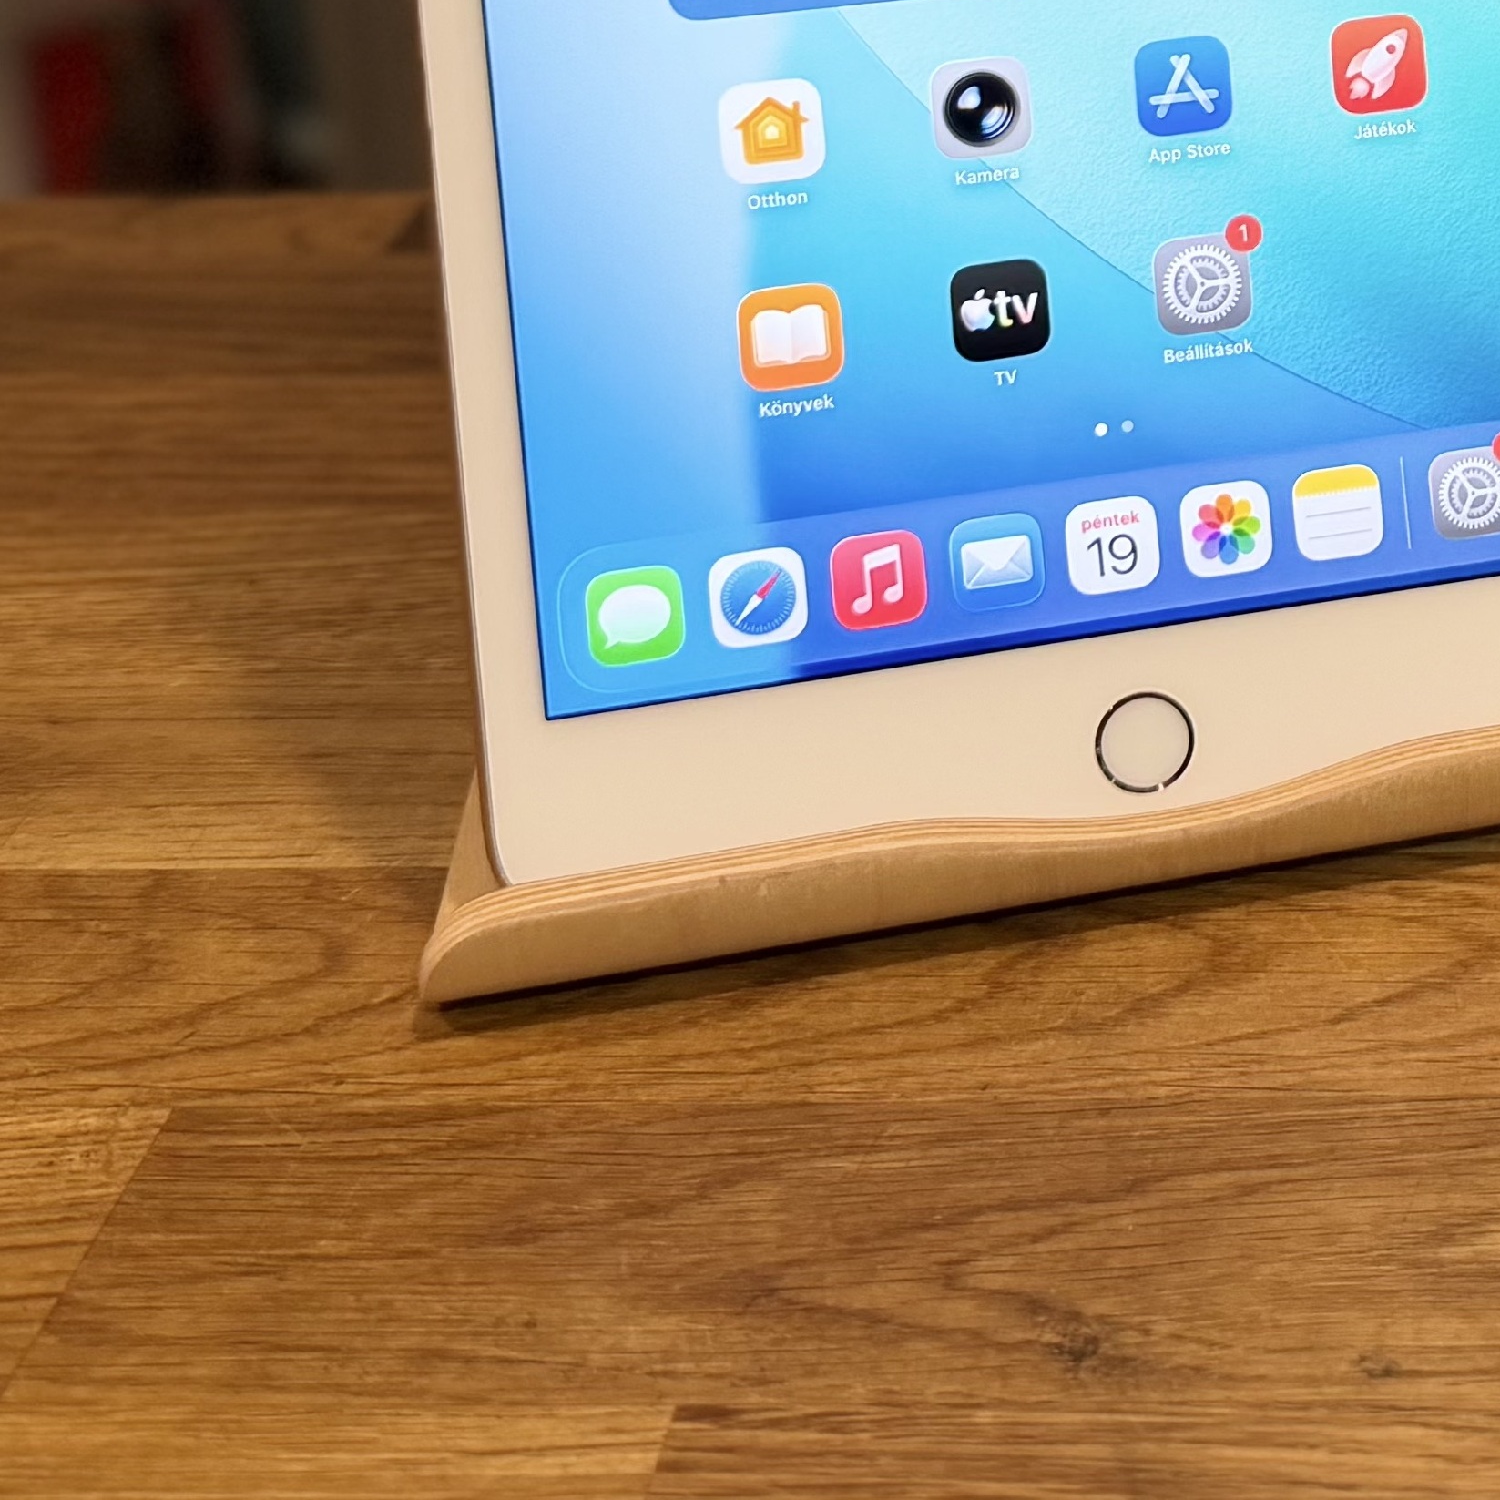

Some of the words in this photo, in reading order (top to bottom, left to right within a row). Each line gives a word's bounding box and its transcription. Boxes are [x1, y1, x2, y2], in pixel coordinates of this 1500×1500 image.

[1354, 119, 1417, 140] Játékok
[1149, 146, 1181, 164] App
[1187, 142, 1231, 159] Store
[955, 166, 1020, 185] Kamera
[747, 190, 809, 210] Otthon
[1238, 223, 1249, 241] 1
[994, 289, 1038, 327] tv
[1164, 338, 1253, 364] Beállítások
[994, 369, 1017, 386] TV
[759, 393, 834, 419] Könyvek
[1081, 510, 1140, 534] péntek
[1086, 533, 1139, 578] 19
